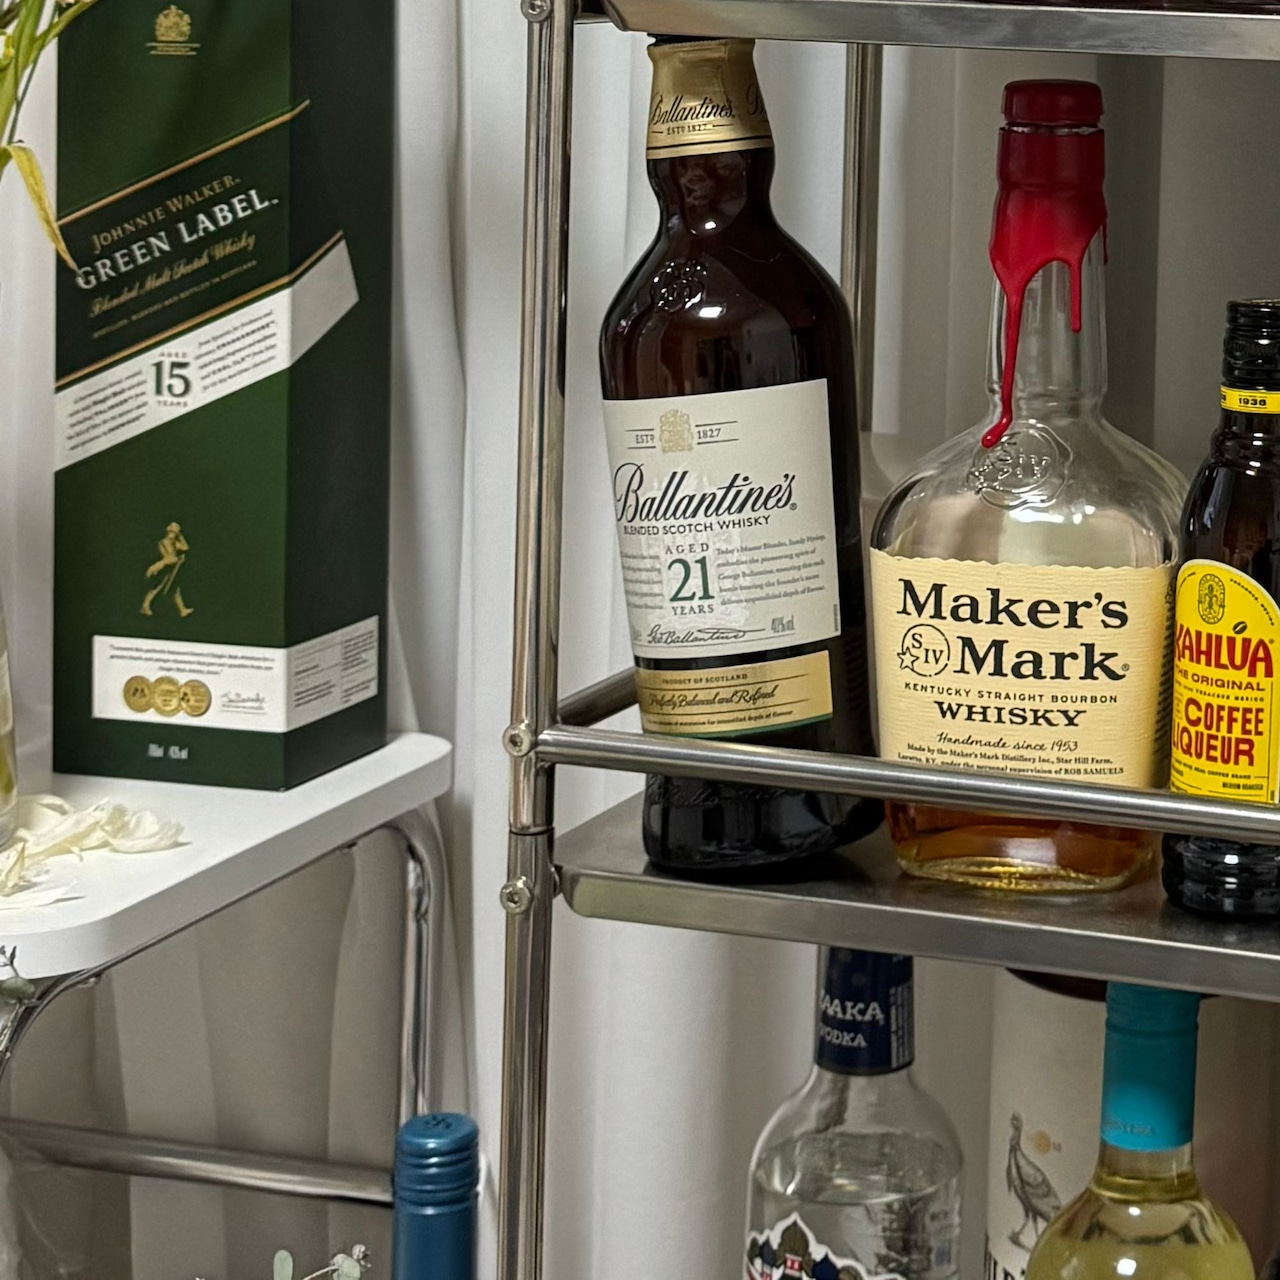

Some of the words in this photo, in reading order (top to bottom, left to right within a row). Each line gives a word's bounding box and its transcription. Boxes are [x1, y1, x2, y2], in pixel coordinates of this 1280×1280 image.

[649, 93, 735, 126] Ballantine's
[91, 206, 167, 254] JOHNNIE
[166, 175, 238, 214] WALKER
[75, 230, 171, 290] GREEN
[152, 359, 192, 399] 15
[697, 427, 722, 441] 1827
[613, 462, 797, 523] Ballantine's
[623, 524, 660, 536] BLENDED
[662, 521, 714, 536] SCOTCH
[716, 514, 772, 532] WHISKY
[665, 542, 710, 556] AGED
[667, 556, 716, 602] 21
[671, 604, 715, 617] YEARS
[896, 578, 1130, 630] Maker's
[953, 635, 1127, 682] Mark
[705, 673, 748, 683] SCOTLAND
[1191, 673, 1266, 692] ORIGINAL
[904, 681, 972, 699] KENTUCKY
[977, 690, 1046, 704] STRAIGHT
[1051, 694, 1119, 705] BOURBON
[934, 700, 1087, 727] WHISKY
[1184, 697, 1265, 737] COFFEE
[936, 731, 1009, 749] Handmade
[1011, 738, 1047, 752] since
[1050, 738, 1079, 752] 1953
[949, 747, 979, 759] Maker's
[979, 752, 1000, 761] Mark
[1073, 756, 1089, 764] Hill
[1083, 767, 1124, 776] SAMUELS
